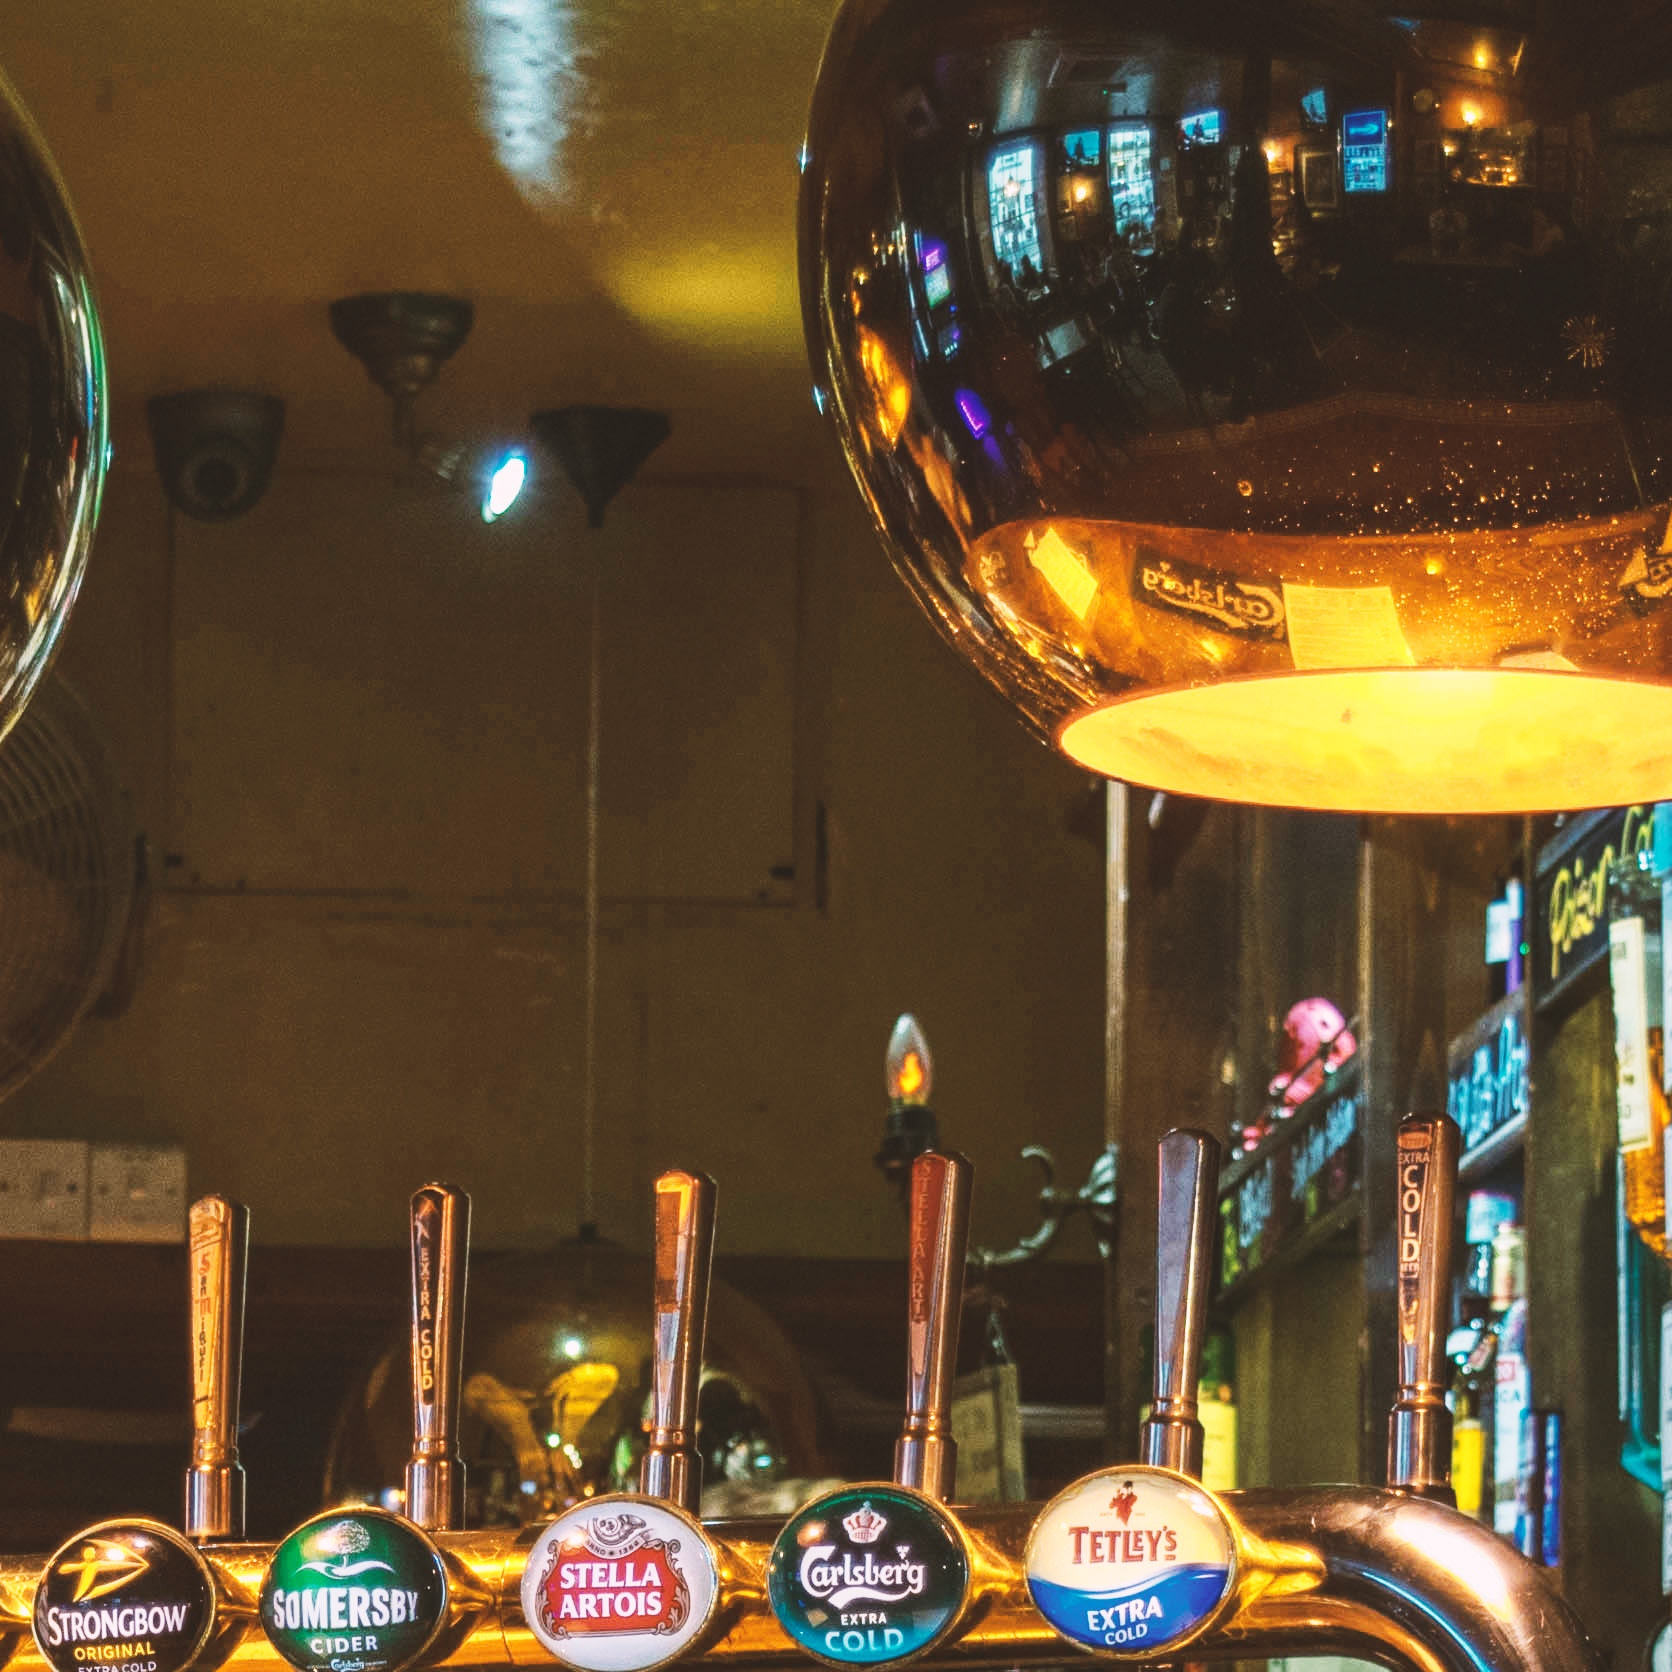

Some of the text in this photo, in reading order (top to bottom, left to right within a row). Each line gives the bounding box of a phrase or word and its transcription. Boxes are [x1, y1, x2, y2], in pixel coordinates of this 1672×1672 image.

[1398, 1152, 1430, 1164] EXTRA
[1401, 1164, 1421, 1263] COLD
[420, 1247, 433, 1391] EXTRA COLD
[1068, 1524, 1178, 1567] TETLEY'S
[559, 1560, 662, 1590] STELLA
[800, 1544, 926, 1600] Carlsberg
[272, 1585, 418, 1631] SOMERSBY
[559, 1592, 663, 1620] ARTOIS
[840, 1612, 888, 1626] EXTRA
[1086, 1596, 1165, 1633] EXTRA
[47, 1604, 187, 1646] STRONGBOW
[1104, 1622, 1149, 1646] COLD
[73, 1641, 157, 1663] ORIGINAL
[310, 1635, 379, 1656] CIDER
[824, 1629, 906, 1654] COLD
